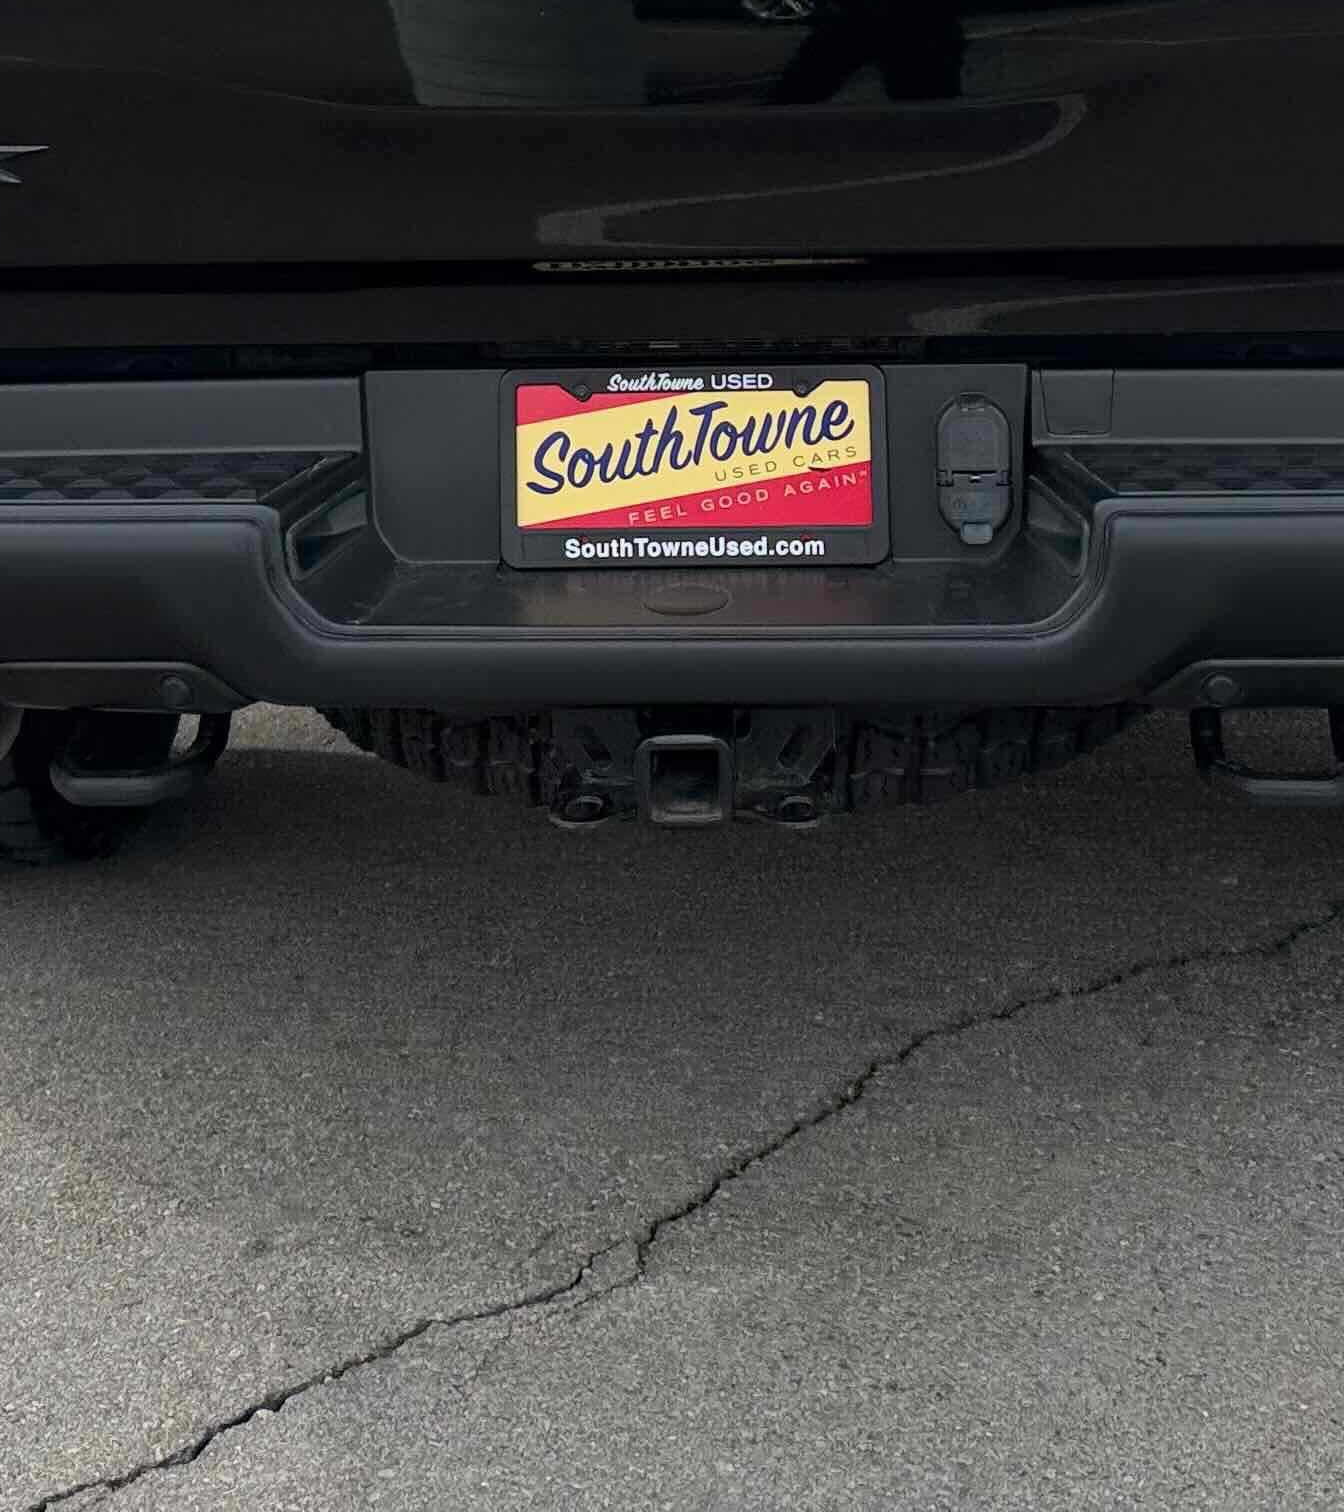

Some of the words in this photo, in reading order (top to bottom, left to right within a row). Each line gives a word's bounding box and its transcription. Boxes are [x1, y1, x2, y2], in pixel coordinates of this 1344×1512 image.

[607, 372, 705, 392] SouthTowne
[711, 374, 774, 389] USED
[526, 399, 855, 496] SouthTowne
[714, 460, 777, 483] USED
[792, 445, 857, 468] CARS
[628, 503, 688, 526] FEEL
[700, 488, 769, 512] GOOD
[564, 536, 825, 559] SouthTowneUsed.com
